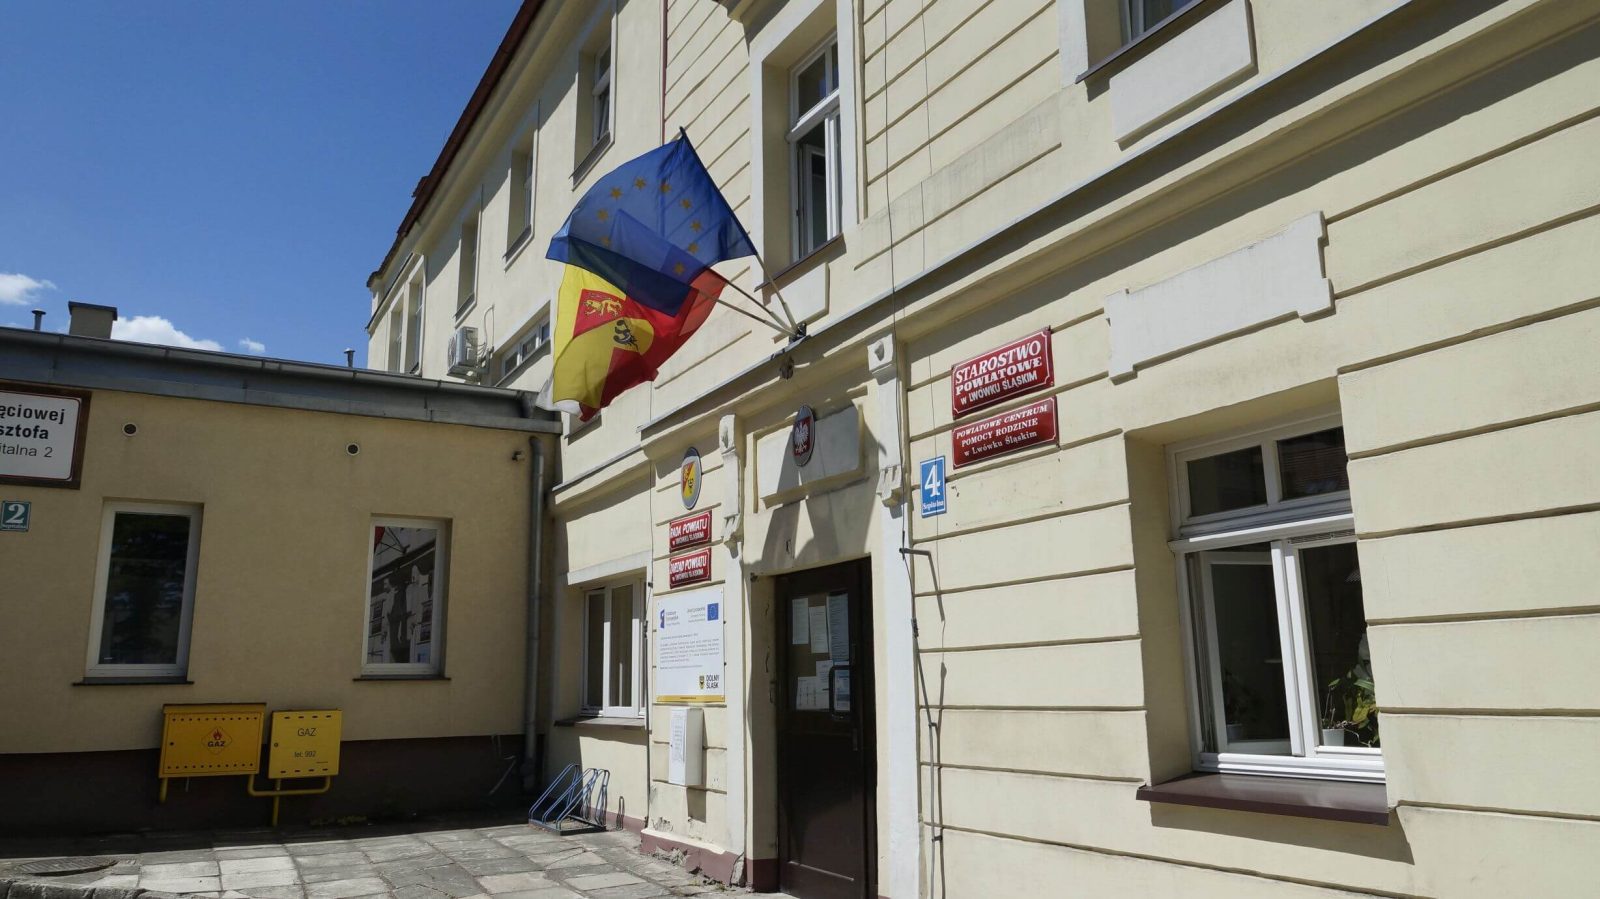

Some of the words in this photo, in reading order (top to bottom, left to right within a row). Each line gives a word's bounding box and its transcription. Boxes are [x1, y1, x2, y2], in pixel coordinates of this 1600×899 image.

[955, 340, 1041, 384] STAROSTWO
[956, 357, 1042, 395] POWIATOWE
[960, 397, 966, 405] w
[969, 383, 1001, 402] LWÓWKU
[1003, 370, 1038, 390] ŚLĄSKIM
[956, 419, 1001, 440] POWIATOWE
[1004, 404, 1048, 423] CENTRUM
[961, 431, 993, 447] POMOCY
[995, 417, 1038, 436] RODZINIE
[43, 446, 53, 458] 2
[972, 440, 1003, 455] Lwówku
[1005, 430, 1037, 445] Śląskim
[924, 464, 941, 497] 4
[5, 503, 26, 524] 2
[682, 517, 708, 535] POWIATU
[684, 555, 707, 570] POWIATU
[207, 740, 225, 748] GAZ
[297, 727, 316, 737] GAZ
